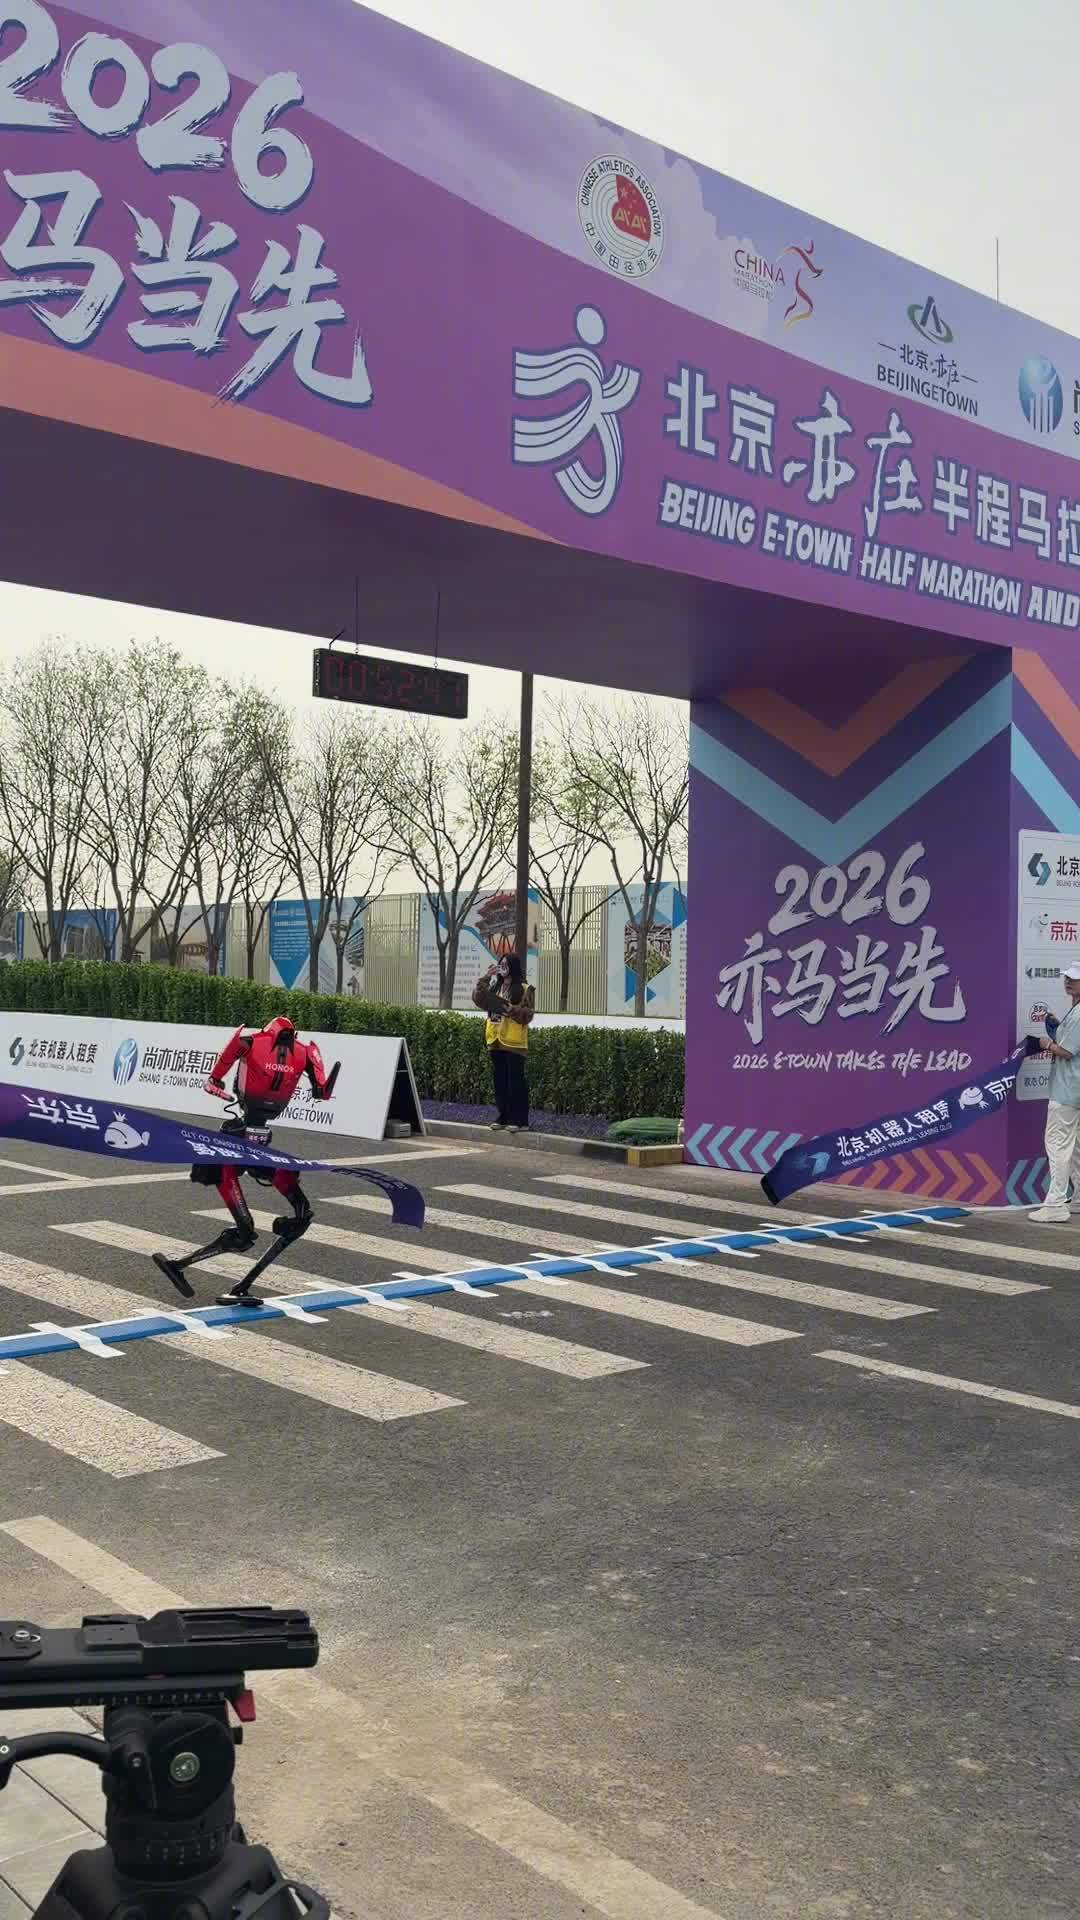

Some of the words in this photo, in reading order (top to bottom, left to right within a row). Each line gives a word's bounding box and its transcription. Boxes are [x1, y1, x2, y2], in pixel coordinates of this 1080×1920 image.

[0, 0, 314, 211] 2026
[581, 168, 599, 206] CHINESE
[598, 160, 634, 178] ATHLETICS
[635, 176, 661, 236] ASSOCIATION
[0, 169, 373, 408] 马当先
[735, 249, 786, 286] CHINA
[877, 363, 979, 417] BEIJINGETOWN
[660, 482, 755, 544] BEIJING
[763, 512, 853, 572] E-TOWN
[860, 542, 917, 587] HALF
[918, 559, 1023, 616] MARATHON
[1027, 585, 1080, 627] AND
[768, 842, 932, 937] 2026
[1050, 920, 1078, 942] 京东
[715, 927, 968, 1045] 亦马当先
[28, 1038, 98, 1065] 北京机器人租赁
[142, 1046, 218, 1075] 尚亦城集团
[265, 1062, 294, 1073] HONOR
[732, 1053, 769, 1070] 2026
[773, 1051, 833, 1072] E-TOWN
[835, 1050, 886, 1071] TAKES
[891, 1047, 922, 1078] THE
[924, 1050, 973, 1072] LEAD
[139, 1071, 161, 1084] SHANG
[163, 1075, 188, 1088] E-TOWN
[20, 1093, 100, 1131] 京东
[836, 1100, 951, 1158] 北京机器人租赁
